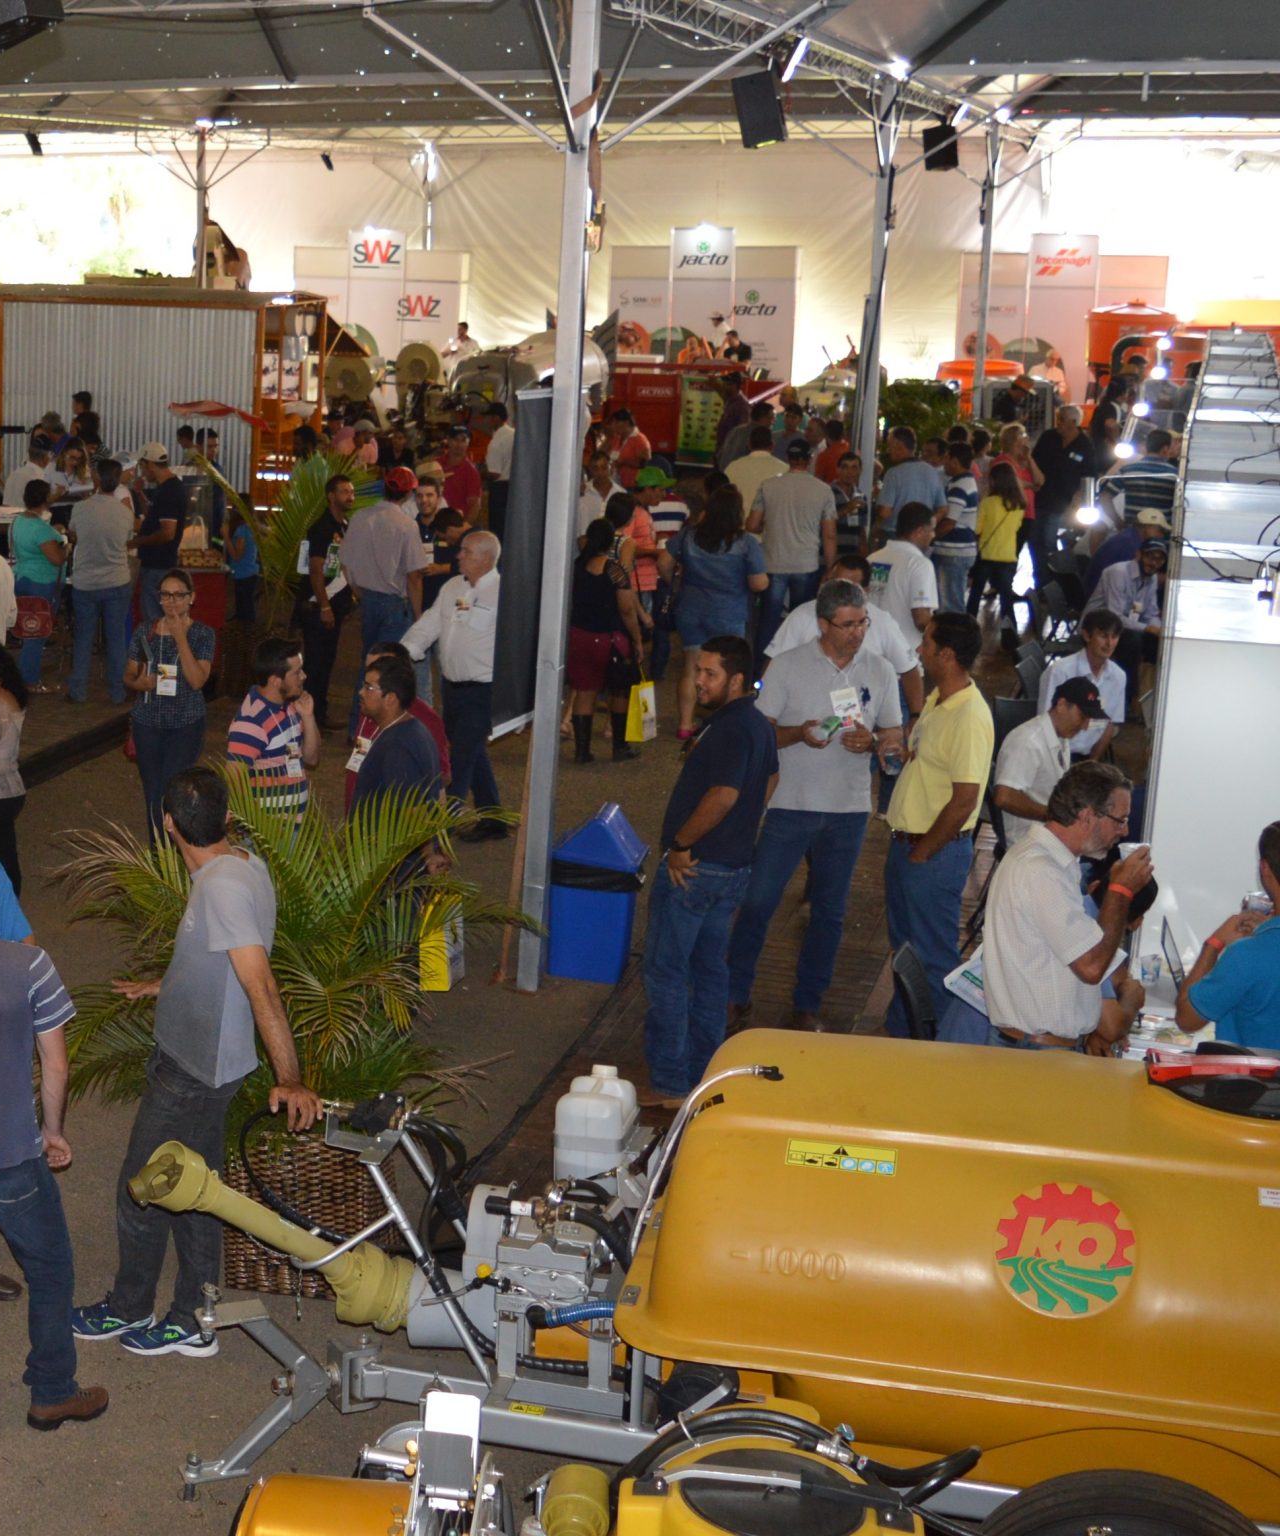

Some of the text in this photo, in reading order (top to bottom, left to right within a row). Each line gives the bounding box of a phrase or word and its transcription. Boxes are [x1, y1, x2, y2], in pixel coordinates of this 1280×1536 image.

[353, 240, 400, 264] SWZ
[677, 252, 729, 268] jacto
[1035, 254, 1092, 268] Incomagri
[397, 295, 441, 318] SWZ
[1017, 1215, 1118, 1270] KO
[760, 1243, 847, 1282] 1000
